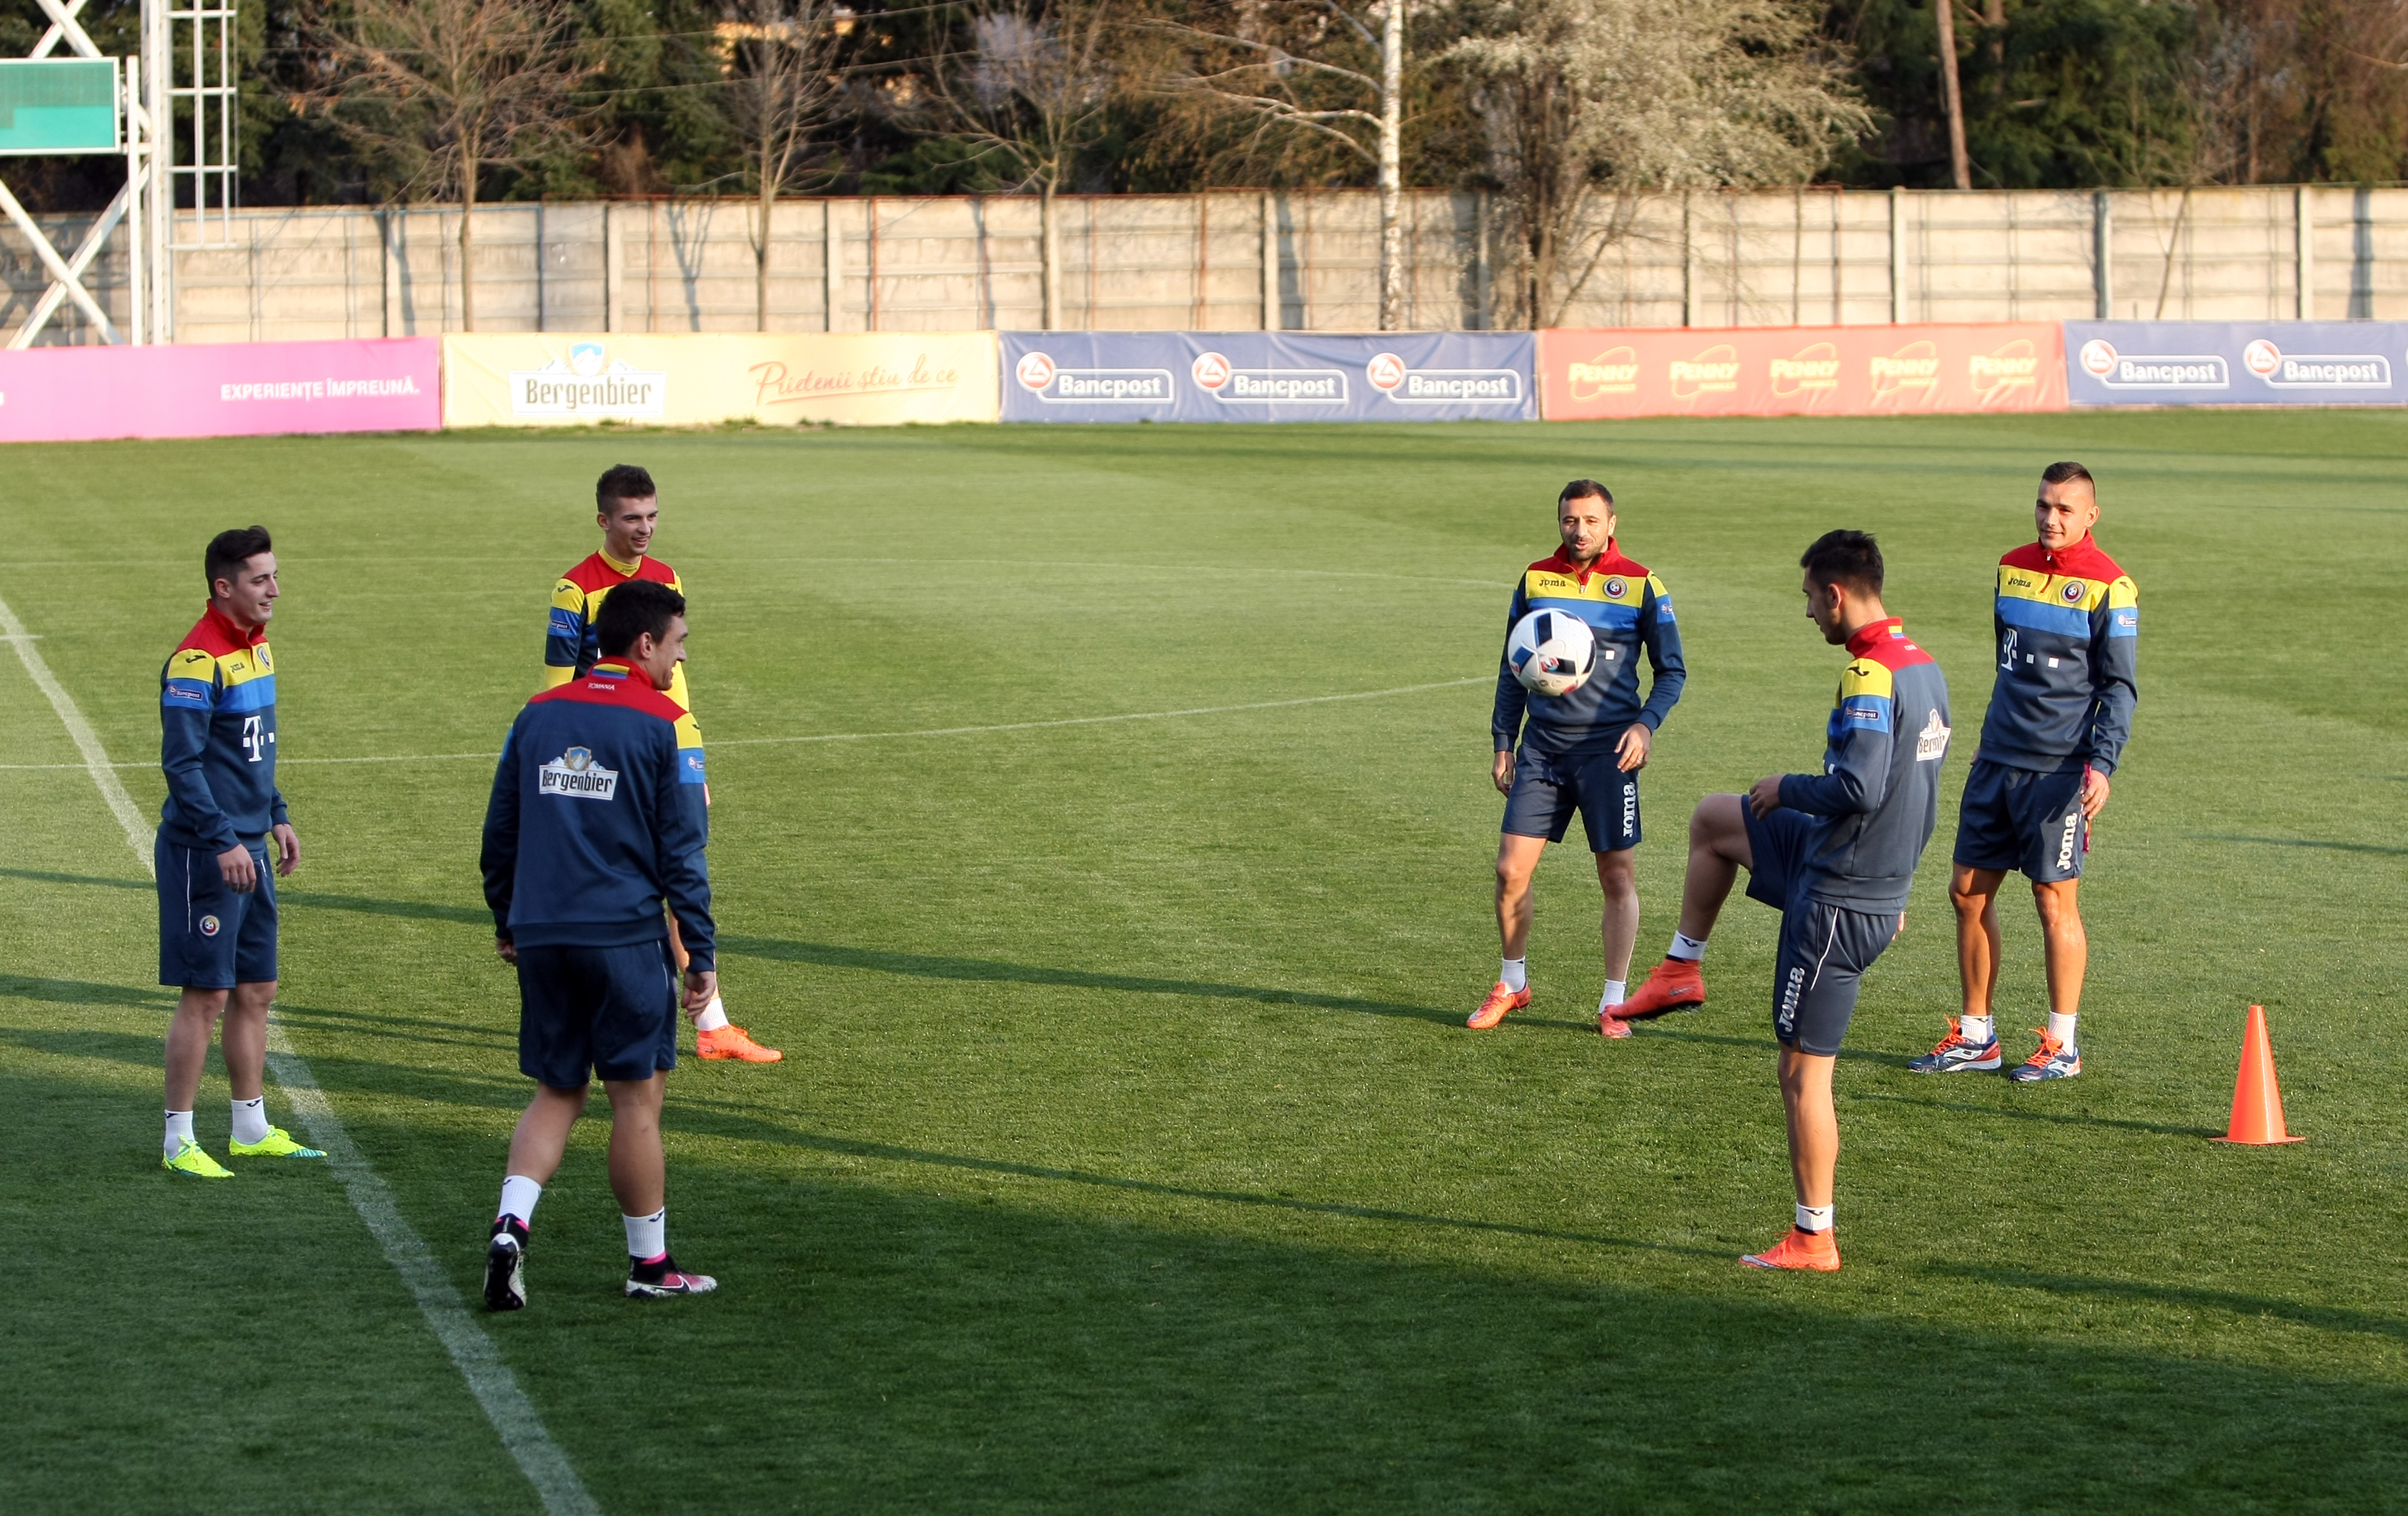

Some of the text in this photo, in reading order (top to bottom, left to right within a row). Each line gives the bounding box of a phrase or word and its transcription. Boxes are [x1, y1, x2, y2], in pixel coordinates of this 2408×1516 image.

[907, 353, 930, 384] de
[936, 367, 957, 383] ce
[1568, 363, 1638, 382] PENNY
[1669, 361, 1740, 381] PENNY
[1770, 359, 1841, 378] PENNY
[1870, 357, 1940, 376] PENNY
[1969, 356, 2038, 375] PENNY
[2120, 361, 2217, 383] Bancpost
[2284, 361, 2378, 383] Bancpost
[325, 376, 420, 397] ÎMPREUNĂ.
[525, 376, 652, 409] Bergenbier
[1058, 375, 1162, 398] Bancpost
[1235, 375, 1335, 398] Bancpost
[1408, 375, 1509, 398] Bancpost
[542, 769, 612, 793] Bergenbier
